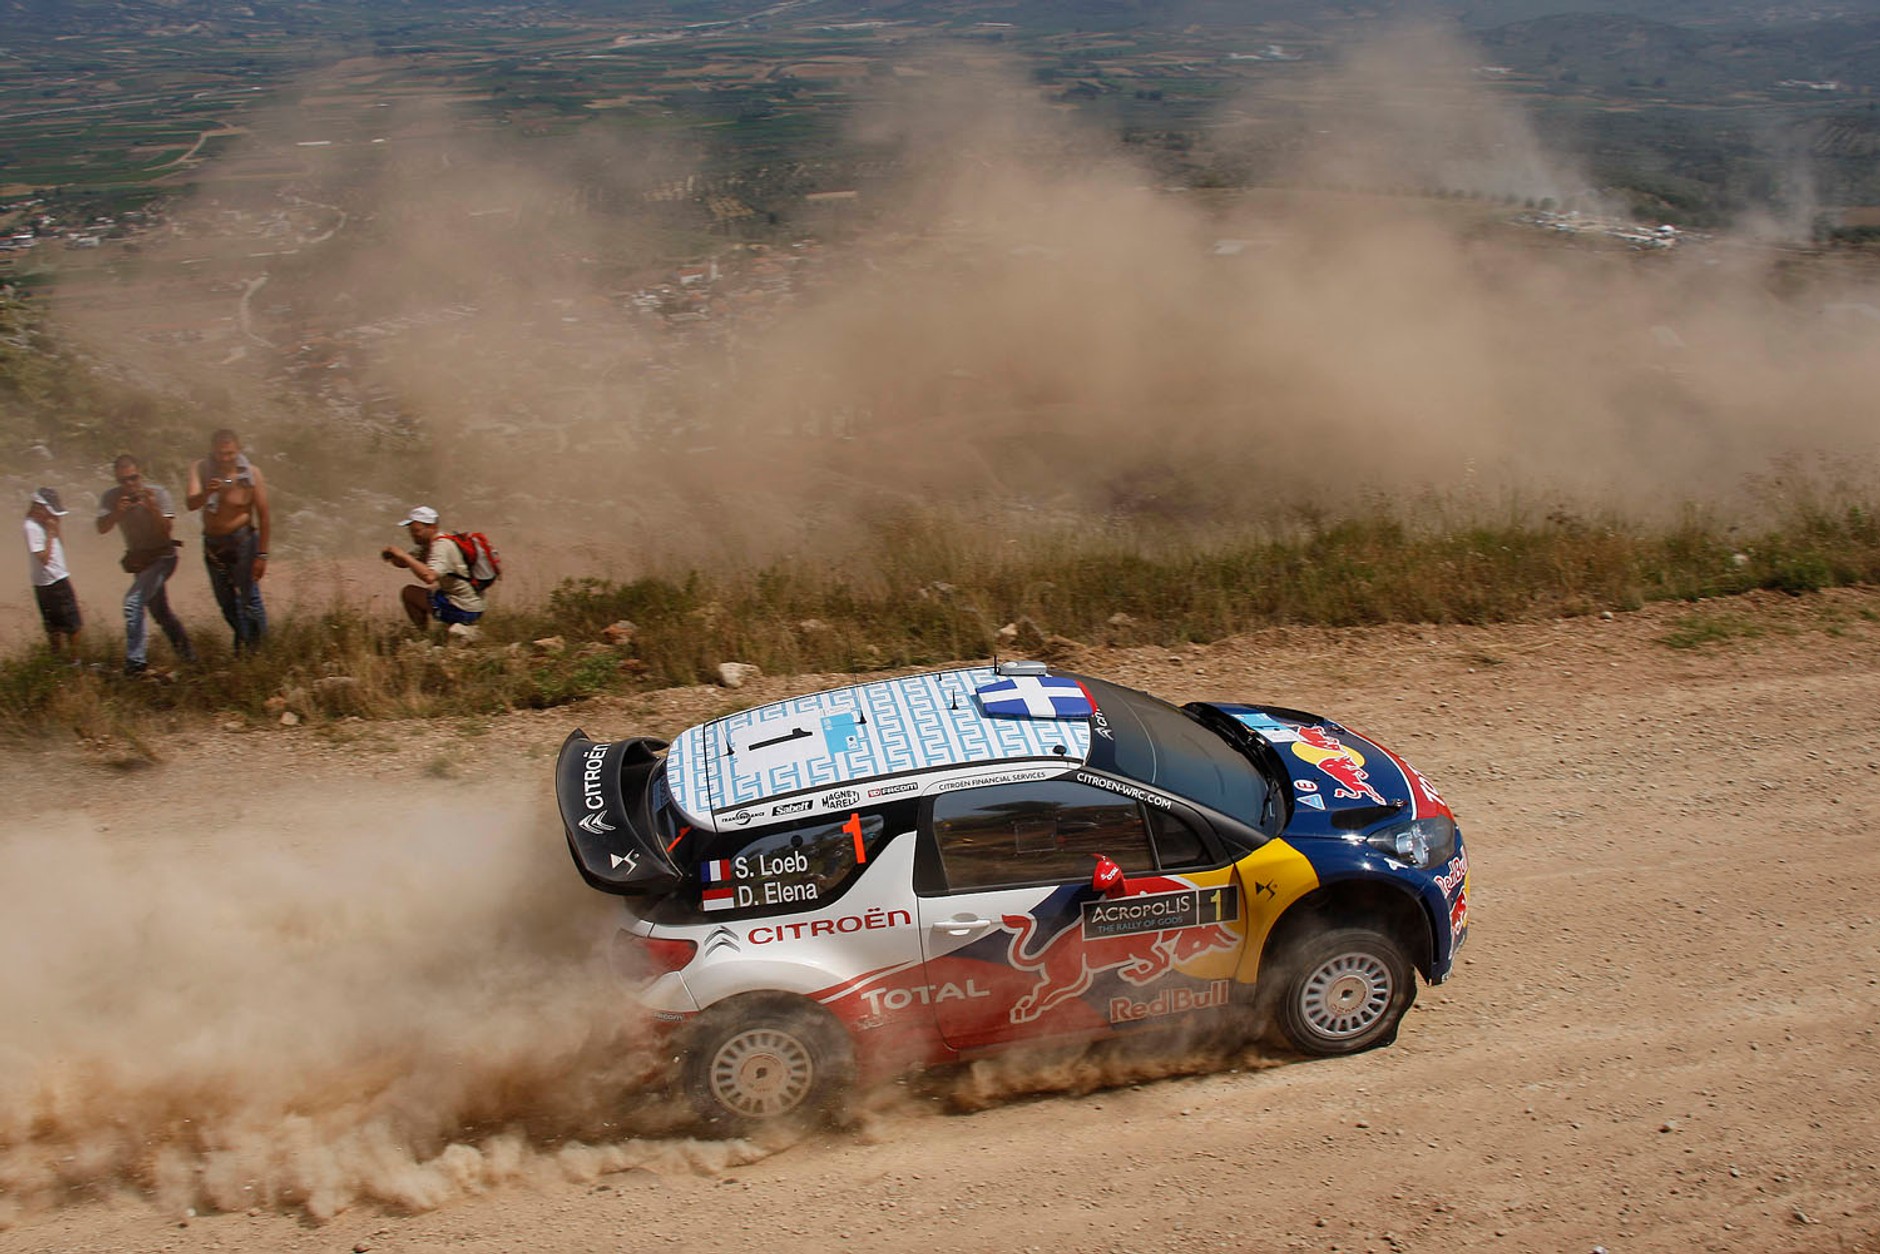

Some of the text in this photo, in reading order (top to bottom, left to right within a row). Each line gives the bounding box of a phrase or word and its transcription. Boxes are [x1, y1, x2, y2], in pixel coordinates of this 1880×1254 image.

[748, 727, 813, 751] 1
[972, 776, 1011, 787] FINANCIAL
[1012, 772, 1046, 782] SERVICES
[1077, 772, 1172, 810] CITROEN-WRC.COM
[776, 801, 810, 815] Sabelt
[842, 813, 866, 864] 1
[735, 850, 808, 879] S. Loeb
[738, 882, 819, 907] D. Elena
[1210, 889, 1222, 921] 1
[1092, 896, 1190, 923] ACROPOLIS
[1116, 920, 1140, 931] RALLY
[1157, 916, 1183, 925] GODS
[860, 979, 990, 1015] TOTAL
